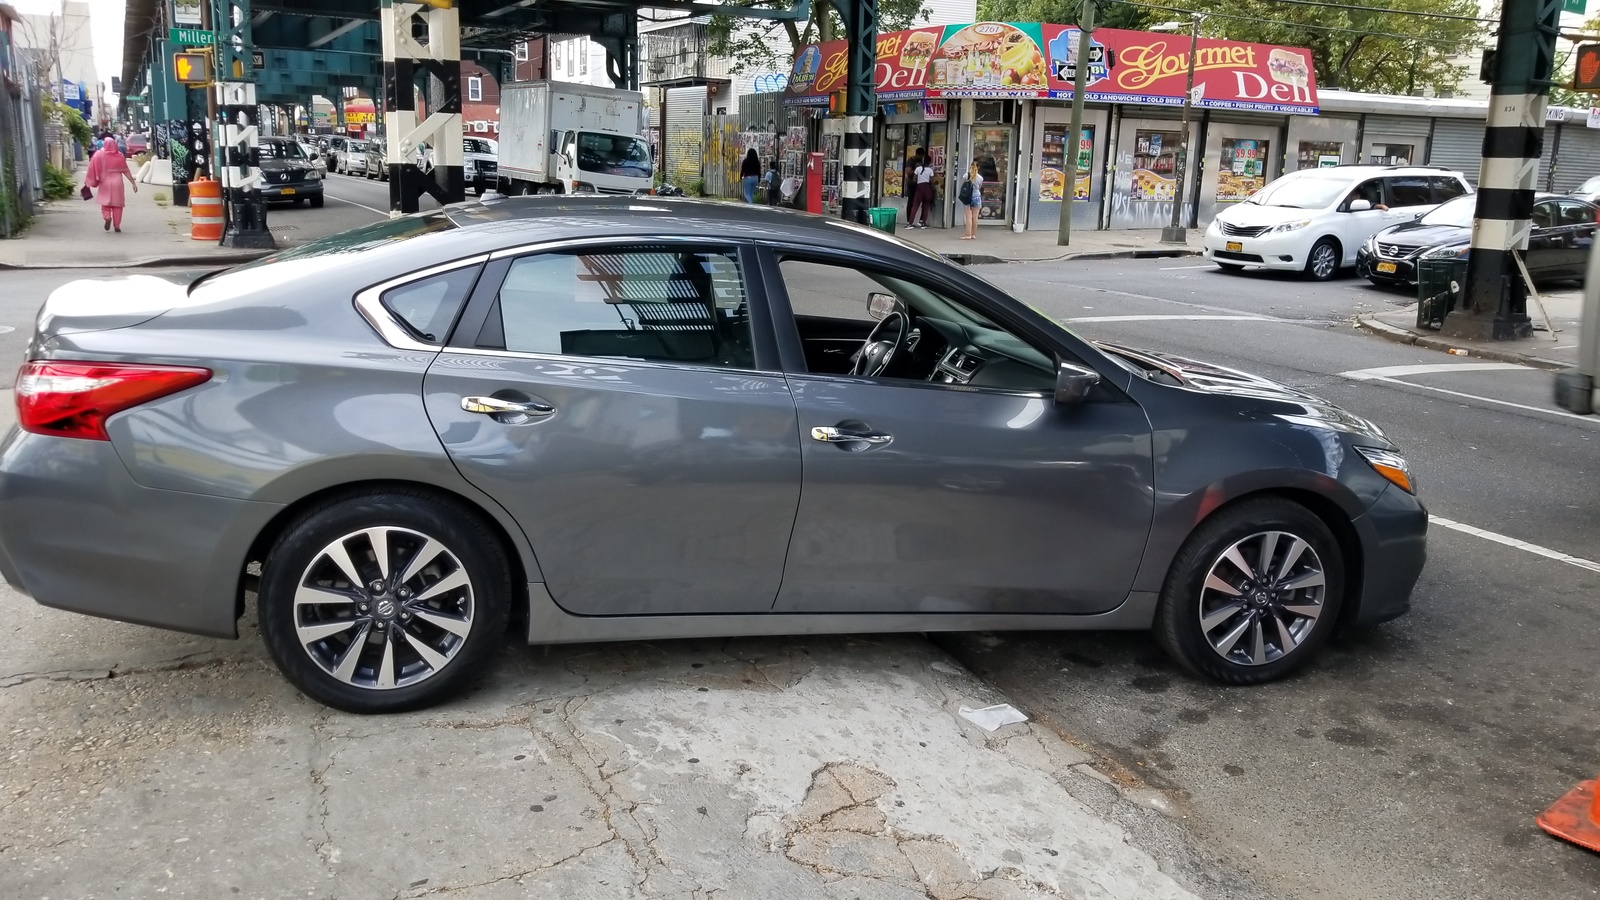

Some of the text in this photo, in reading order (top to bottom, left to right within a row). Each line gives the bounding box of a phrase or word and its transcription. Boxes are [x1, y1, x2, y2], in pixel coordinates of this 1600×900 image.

[979, 25, 1000, 33] 2761
[178, 30, 212, 43] Miller
[1117, 41, 1258, 90] Gourmet
[874, 58, 927, 88] Deli
[1232, 71, 1314, 103] Deli
[925, 103, 945, 115] ATM
[1117, 150, 1132, 165] WE
[1235, 147, 1257, 159] $9.99
